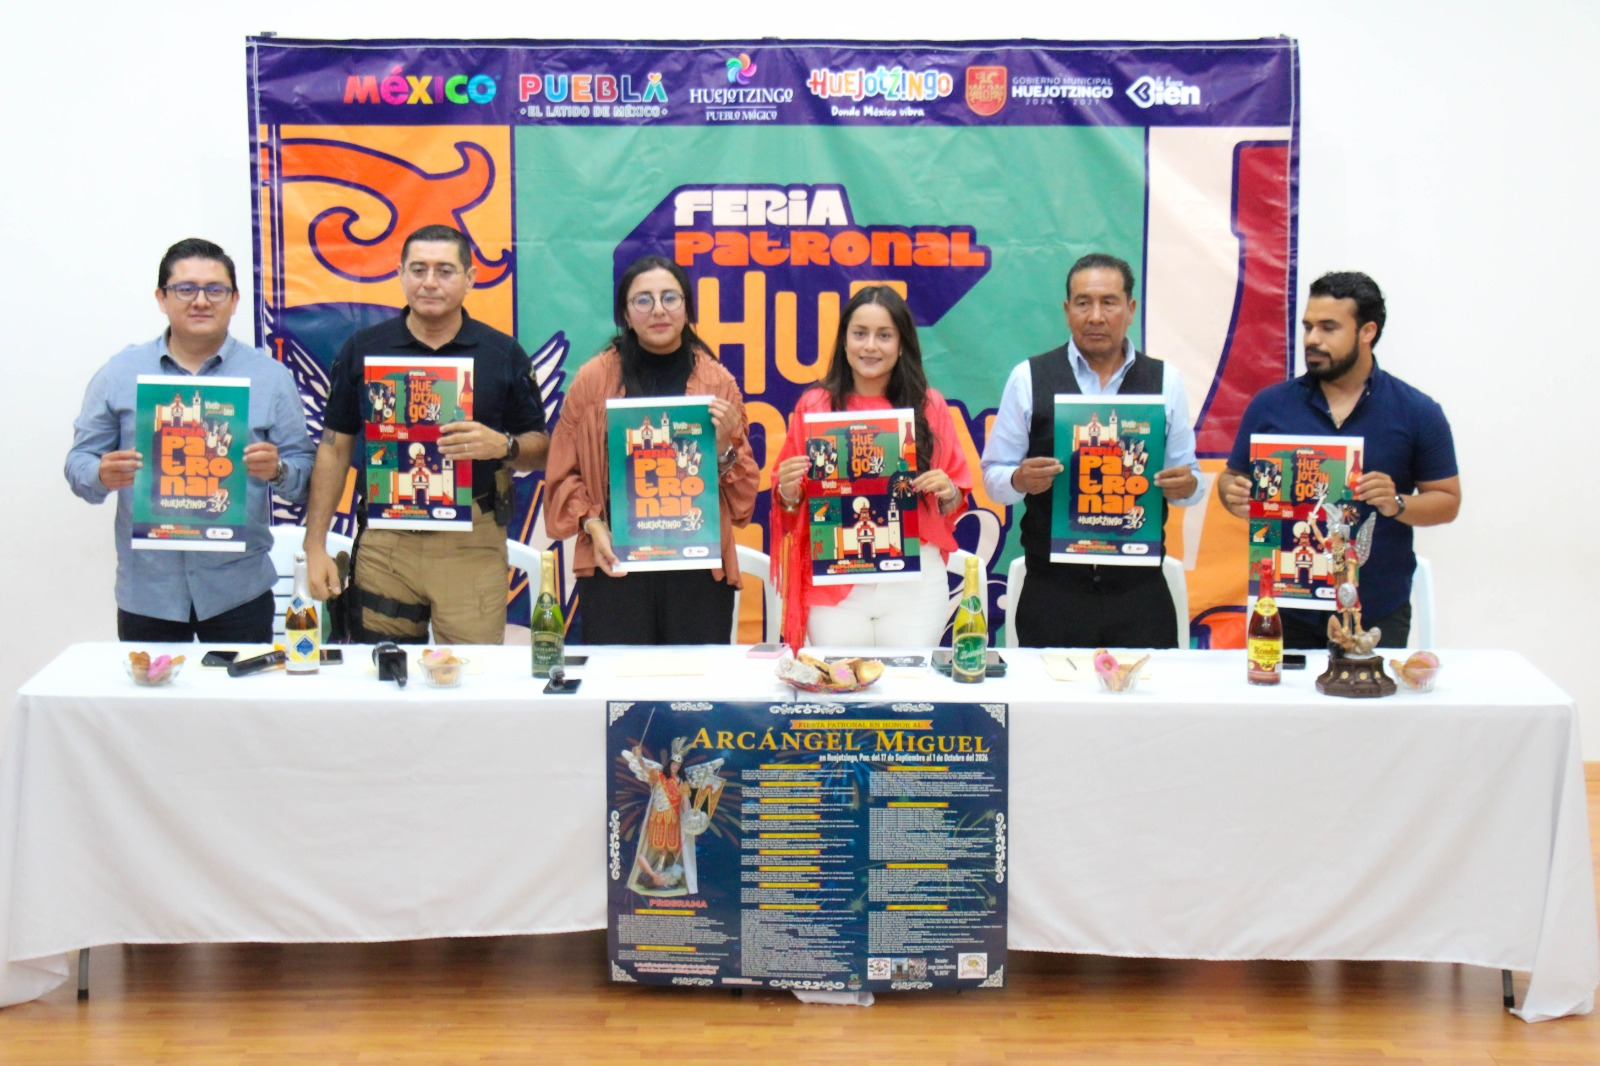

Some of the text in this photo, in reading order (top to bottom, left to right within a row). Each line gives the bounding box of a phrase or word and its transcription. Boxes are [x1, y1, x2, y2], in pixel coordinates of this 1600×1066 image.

[519, 72, 668, 102] PUEBLA
[1012, 77, 1112, 86] GOBIERNO MUNICIPAL
[1012, 86, 1114, 98] HUEJOTZINGO
[528, 104, 660, 118] EL LATIDO DE MÉXICO
[831, 104, 926, 116] Donde México vibra
[410, 380, 432, 392] HUE
[409, 404, 428, 422] go
[850, 434, 874, 446] HUE
[852, 458, 870, 477] go
[1297, 458, 1320, 471] HUE
[1295, 482, 1314, 501] go
[690, 726, 990, 754] ARCÁNGEL MIGUEL
[871, 754, 881, 762] del
[881, 754, 887, 762] 17
[887, 754, 895, 762] de
[926, 754, 932, 762] al
[936, 754, 944, 762] de
[966, 754, 974, 762] del
